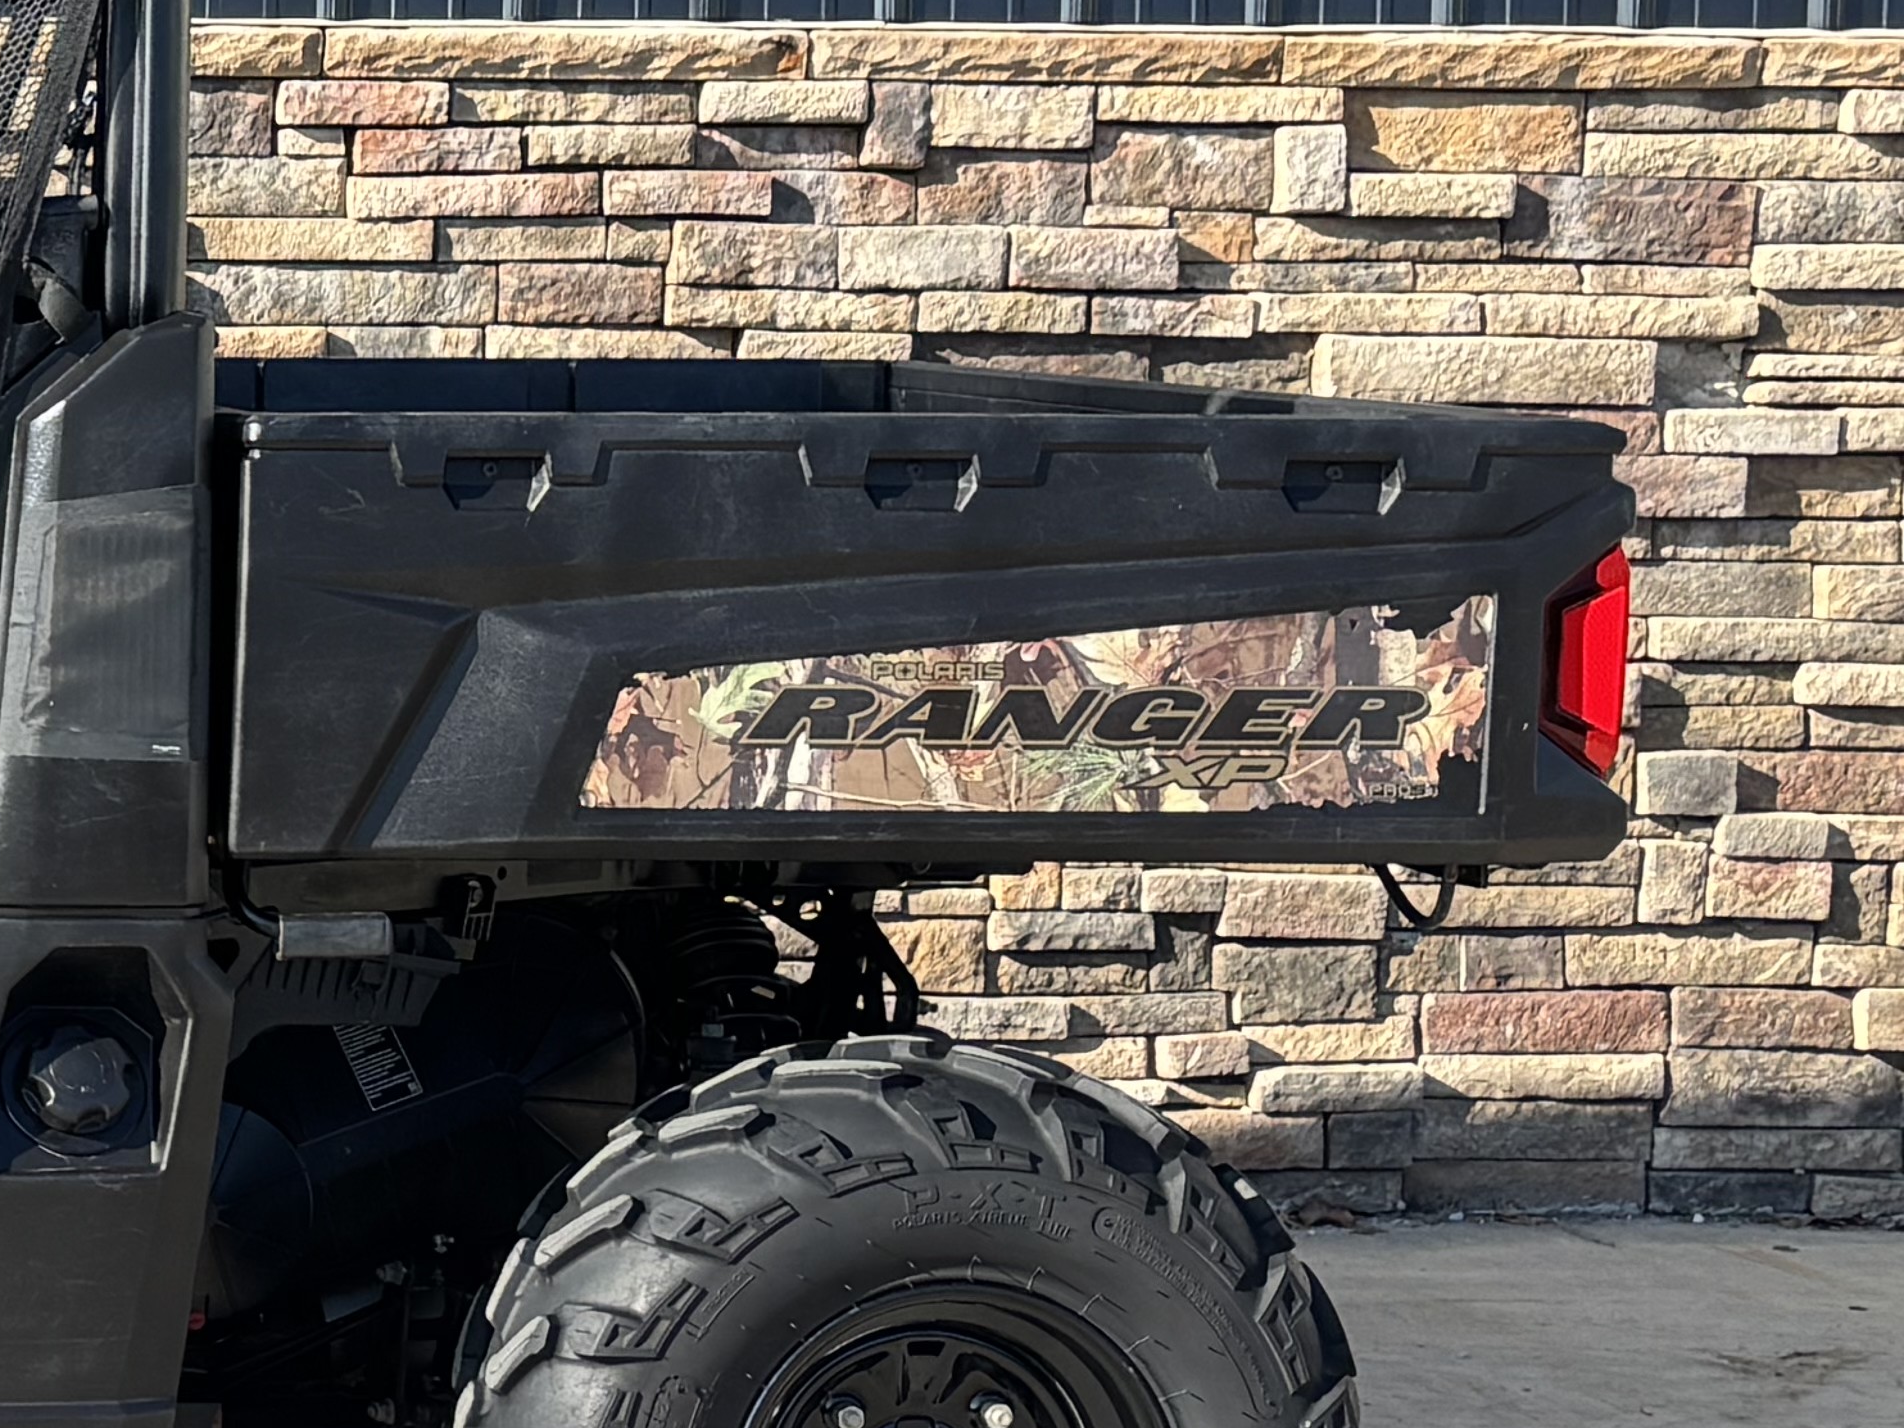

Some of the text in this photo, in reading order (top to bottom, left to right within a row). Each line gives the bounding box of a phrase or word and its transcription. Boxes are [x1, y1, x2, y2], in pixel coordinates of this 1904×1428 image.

[870, 660, 1006, 682] POLARIS
[736, 684, 1432, 751] RANGER
[1120, 754, 1289, 790] XP
